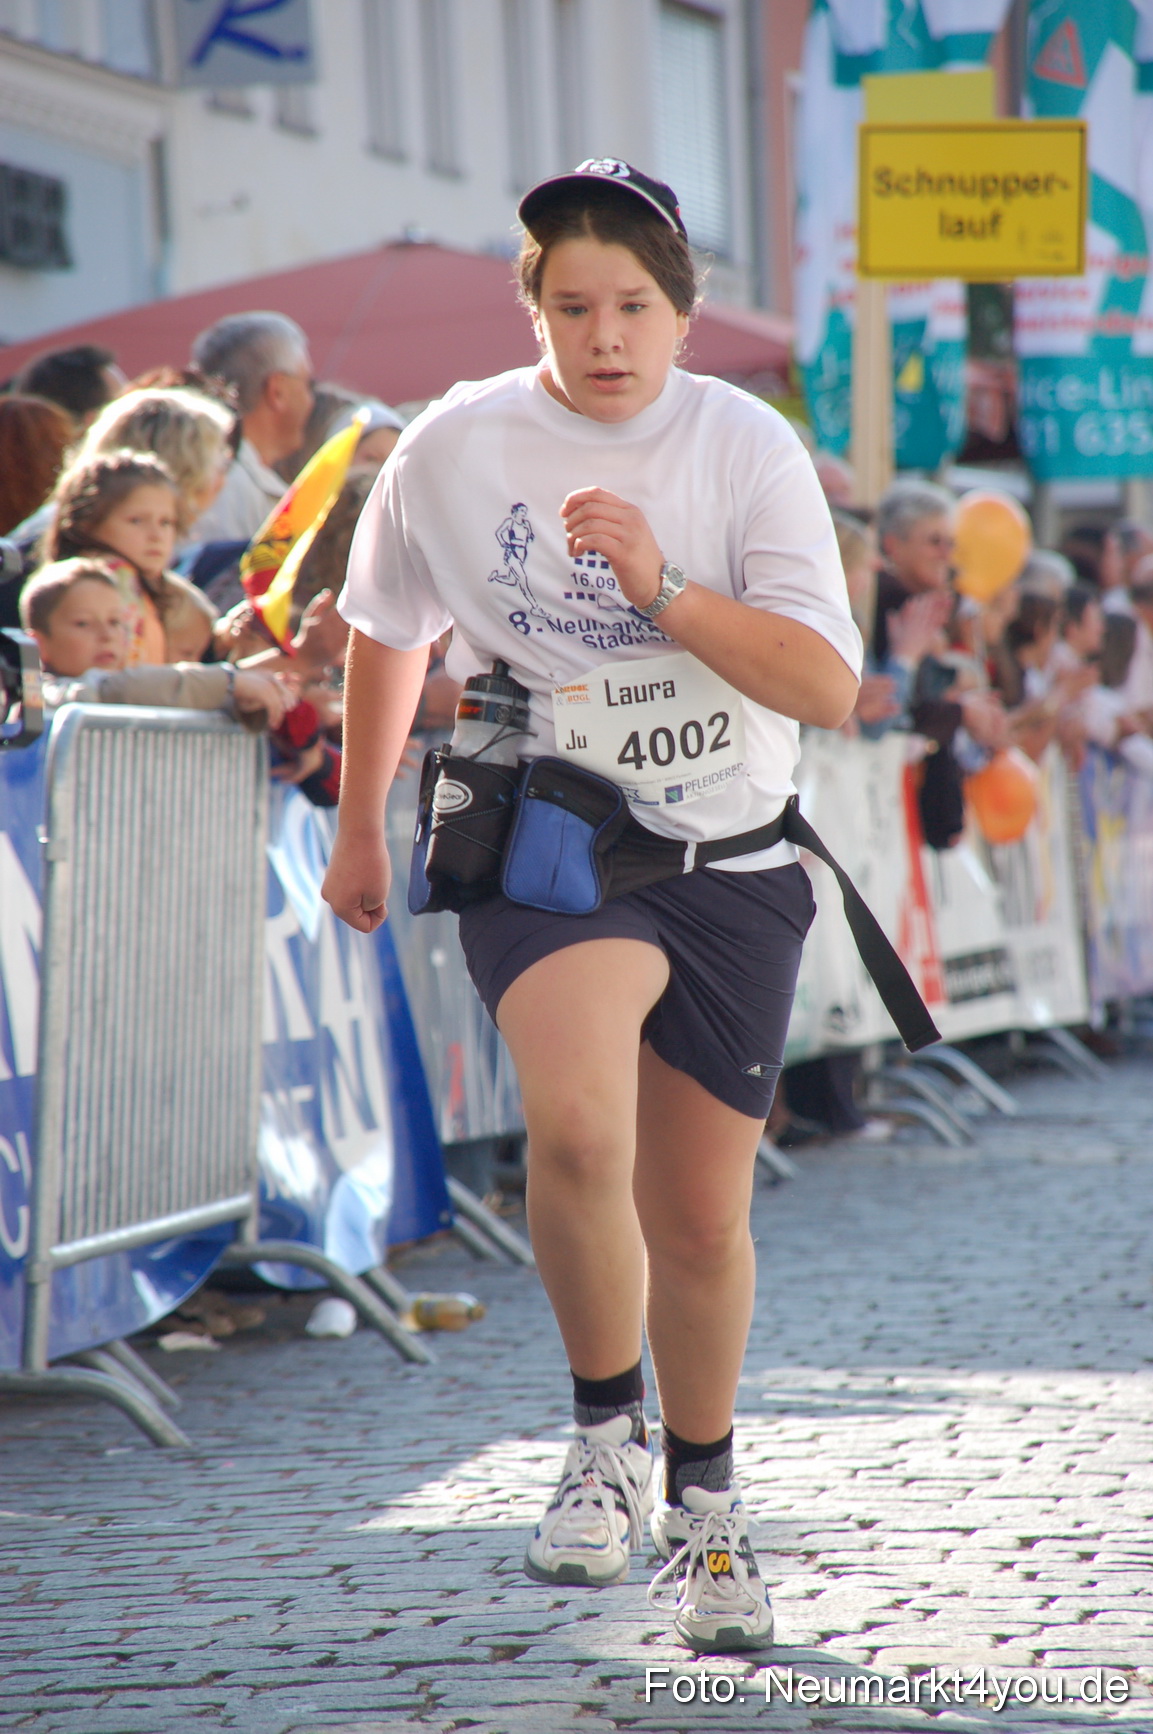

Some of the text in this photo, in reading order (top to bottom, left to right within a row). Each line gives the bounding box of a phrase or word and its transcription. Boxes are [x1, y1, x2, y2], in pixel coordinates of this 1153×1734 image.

[873, 166, 1071, 204] Schnupper-
[938, 207, 1003, 239] lauf
[508, 610, 543, 635] 8.
[604, 678, 676, 707] Laura
[565, 711, 731, 770] Ju 4002
